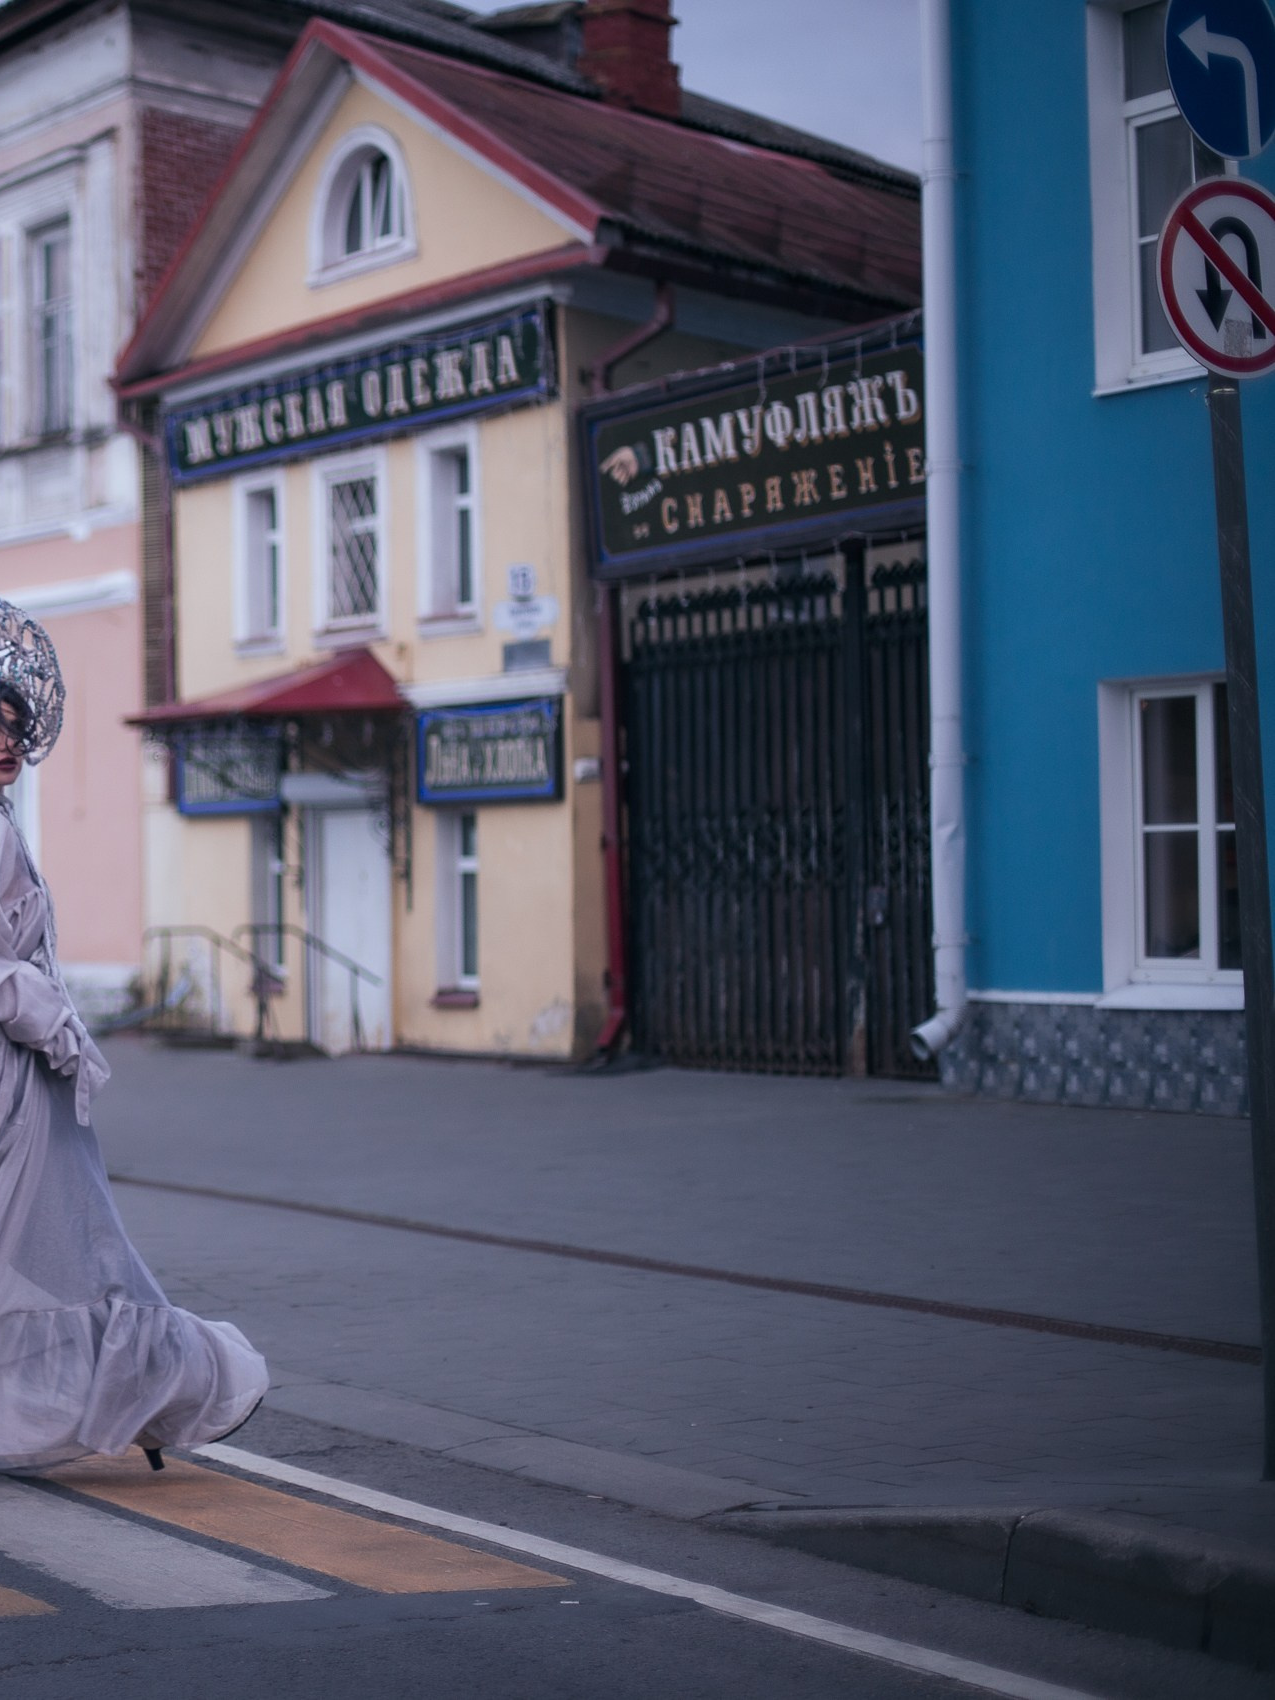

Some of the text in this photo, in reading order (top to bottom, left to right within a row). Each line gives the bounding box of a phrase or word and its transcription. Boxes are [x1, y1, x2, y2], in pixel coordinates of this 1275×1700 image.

[183, 334, 522, 464] МУЖСКАЯ ОДЕЖДА
[651, 369, 921, 477] КАМУФЛЯЖЪ
